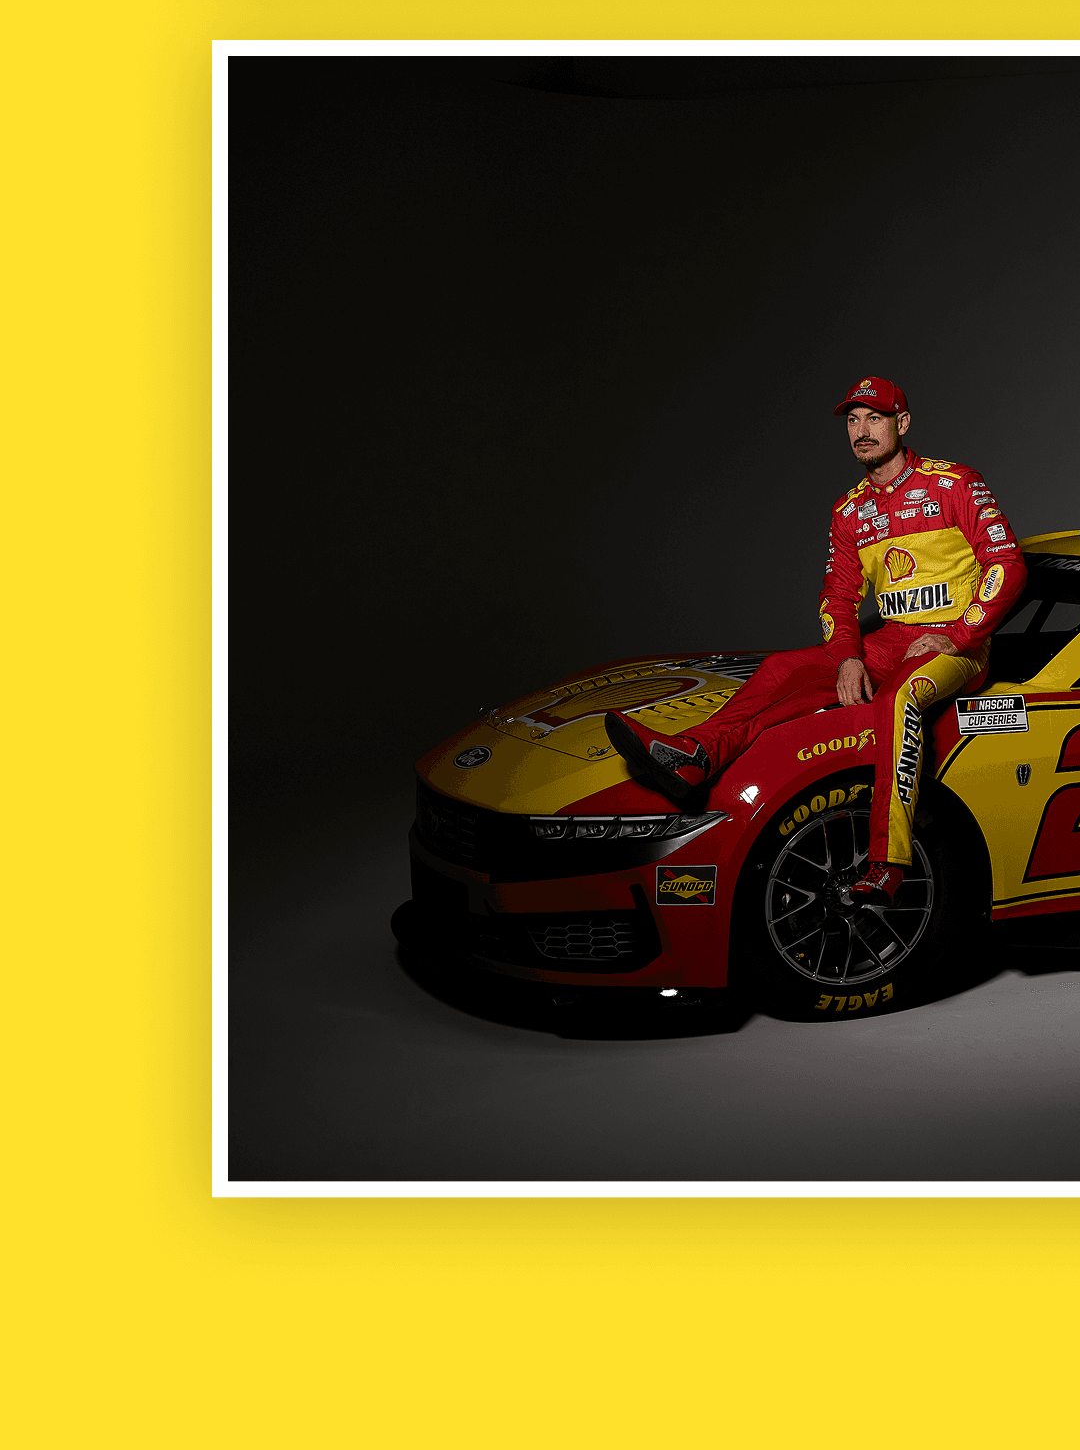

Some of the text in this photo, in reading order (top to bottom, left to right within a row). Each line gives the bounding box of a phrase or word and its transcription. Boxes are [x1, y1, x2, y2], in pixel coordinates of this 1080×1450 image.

[938, 477, 954, 489] OMP
[923, 502, 940, 517] PPG
[984, 567, 1000, 599] PENNZOIL
[877, 582, 954, 618] NNZOIL
[977, 698, 1015, 711] NASCAR
[968, 713, 1018, 727] CUP SERIES
[896, 700, 922, 805] PENNZOIL
[658, 880, 714, 893] SUNOCO
[815, 982, 895, 1012] EAGLE
